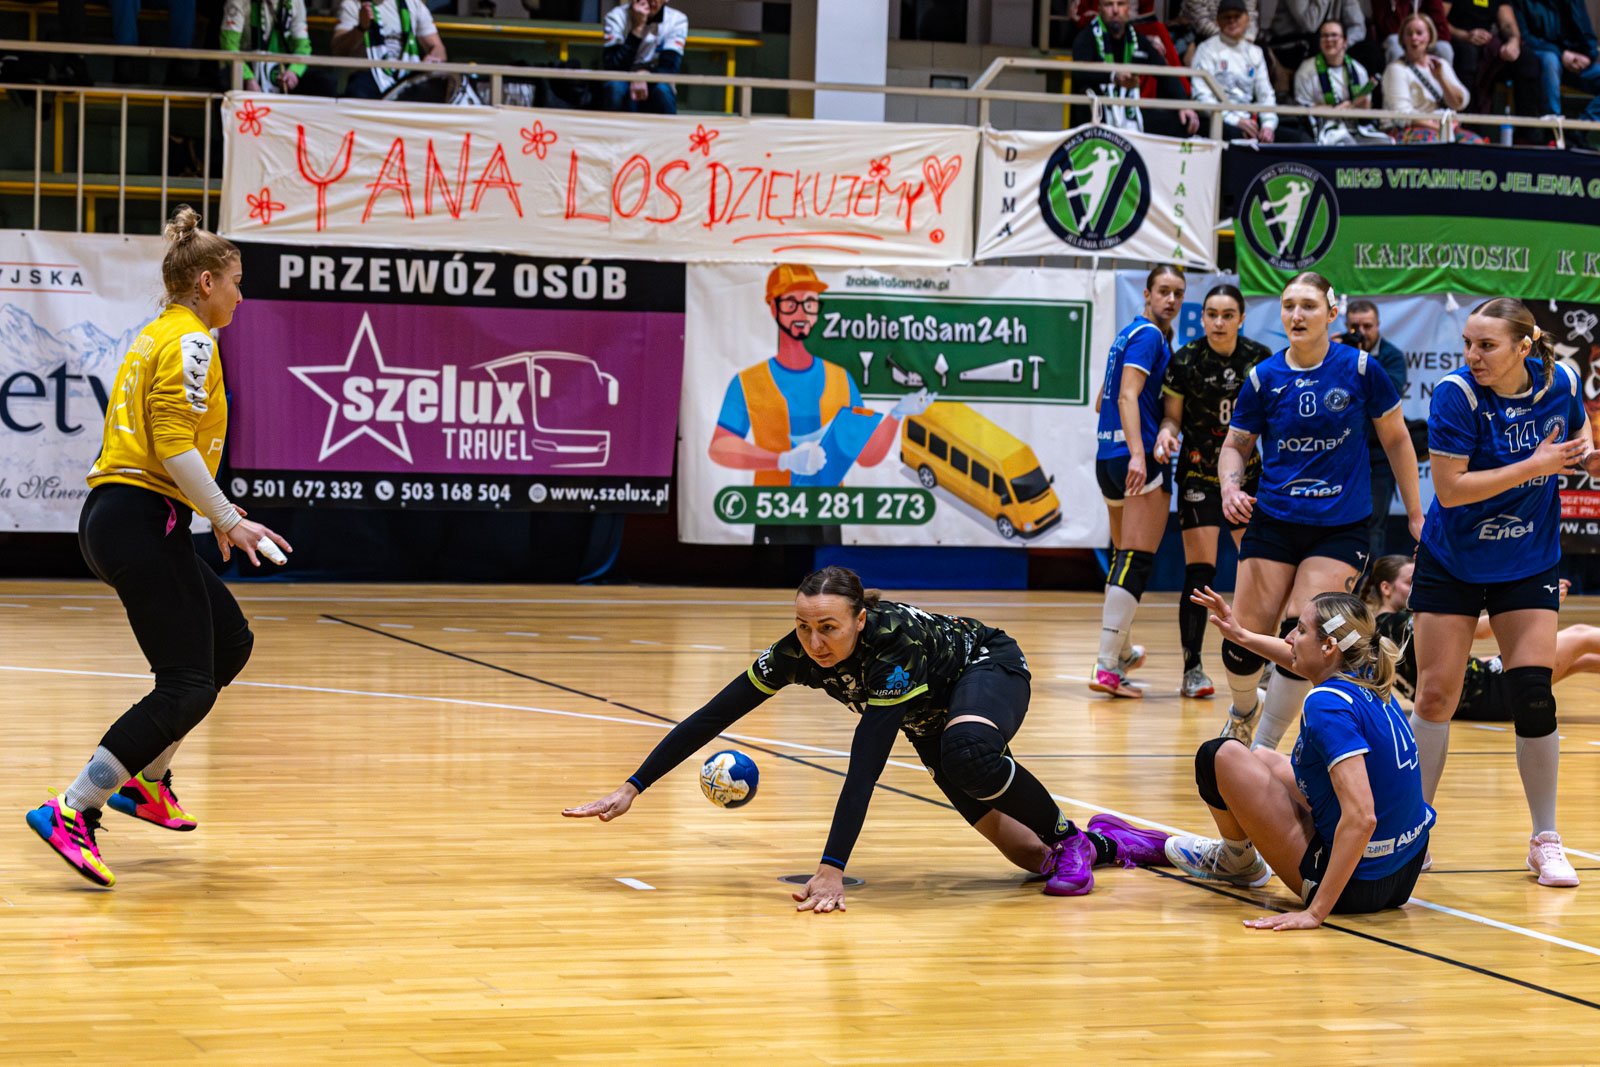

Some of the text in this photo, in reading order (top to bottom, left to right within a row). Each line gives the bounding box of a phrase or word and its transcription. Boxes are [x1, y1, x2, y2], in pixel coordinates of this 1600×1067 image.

[296, 123, 523, 233] YANA
[1336, 168, 1384, 189] MKS
[1386, 168, 1497, 191] VITAMINEO
[1500, 172, 1585, 198] JELENIA
[1354, 243, 1530, 273] KARKONOSKI
[0, 269, 84, 287] JSKA
[279, 253, 628, 300] PRZEWÓZ OSÓB
[823, 312, 1027, 345] ZrobieToSam24h
[342, 365, 526, 425] szelux
[1299, 392, 1317, 417] 8
[1219, 399, 1236, 425] 8
[441, 427, 534, 461] TRAVEL
[1505, 420, 1540, 454] 14
[252, 480, 363, 499] 501 672 332
[401, 482, 511, 501] 503 168 504
[550, 482, 669, 507] www.szelux.pl
[756, 492, 926, 520] 534 281 273
